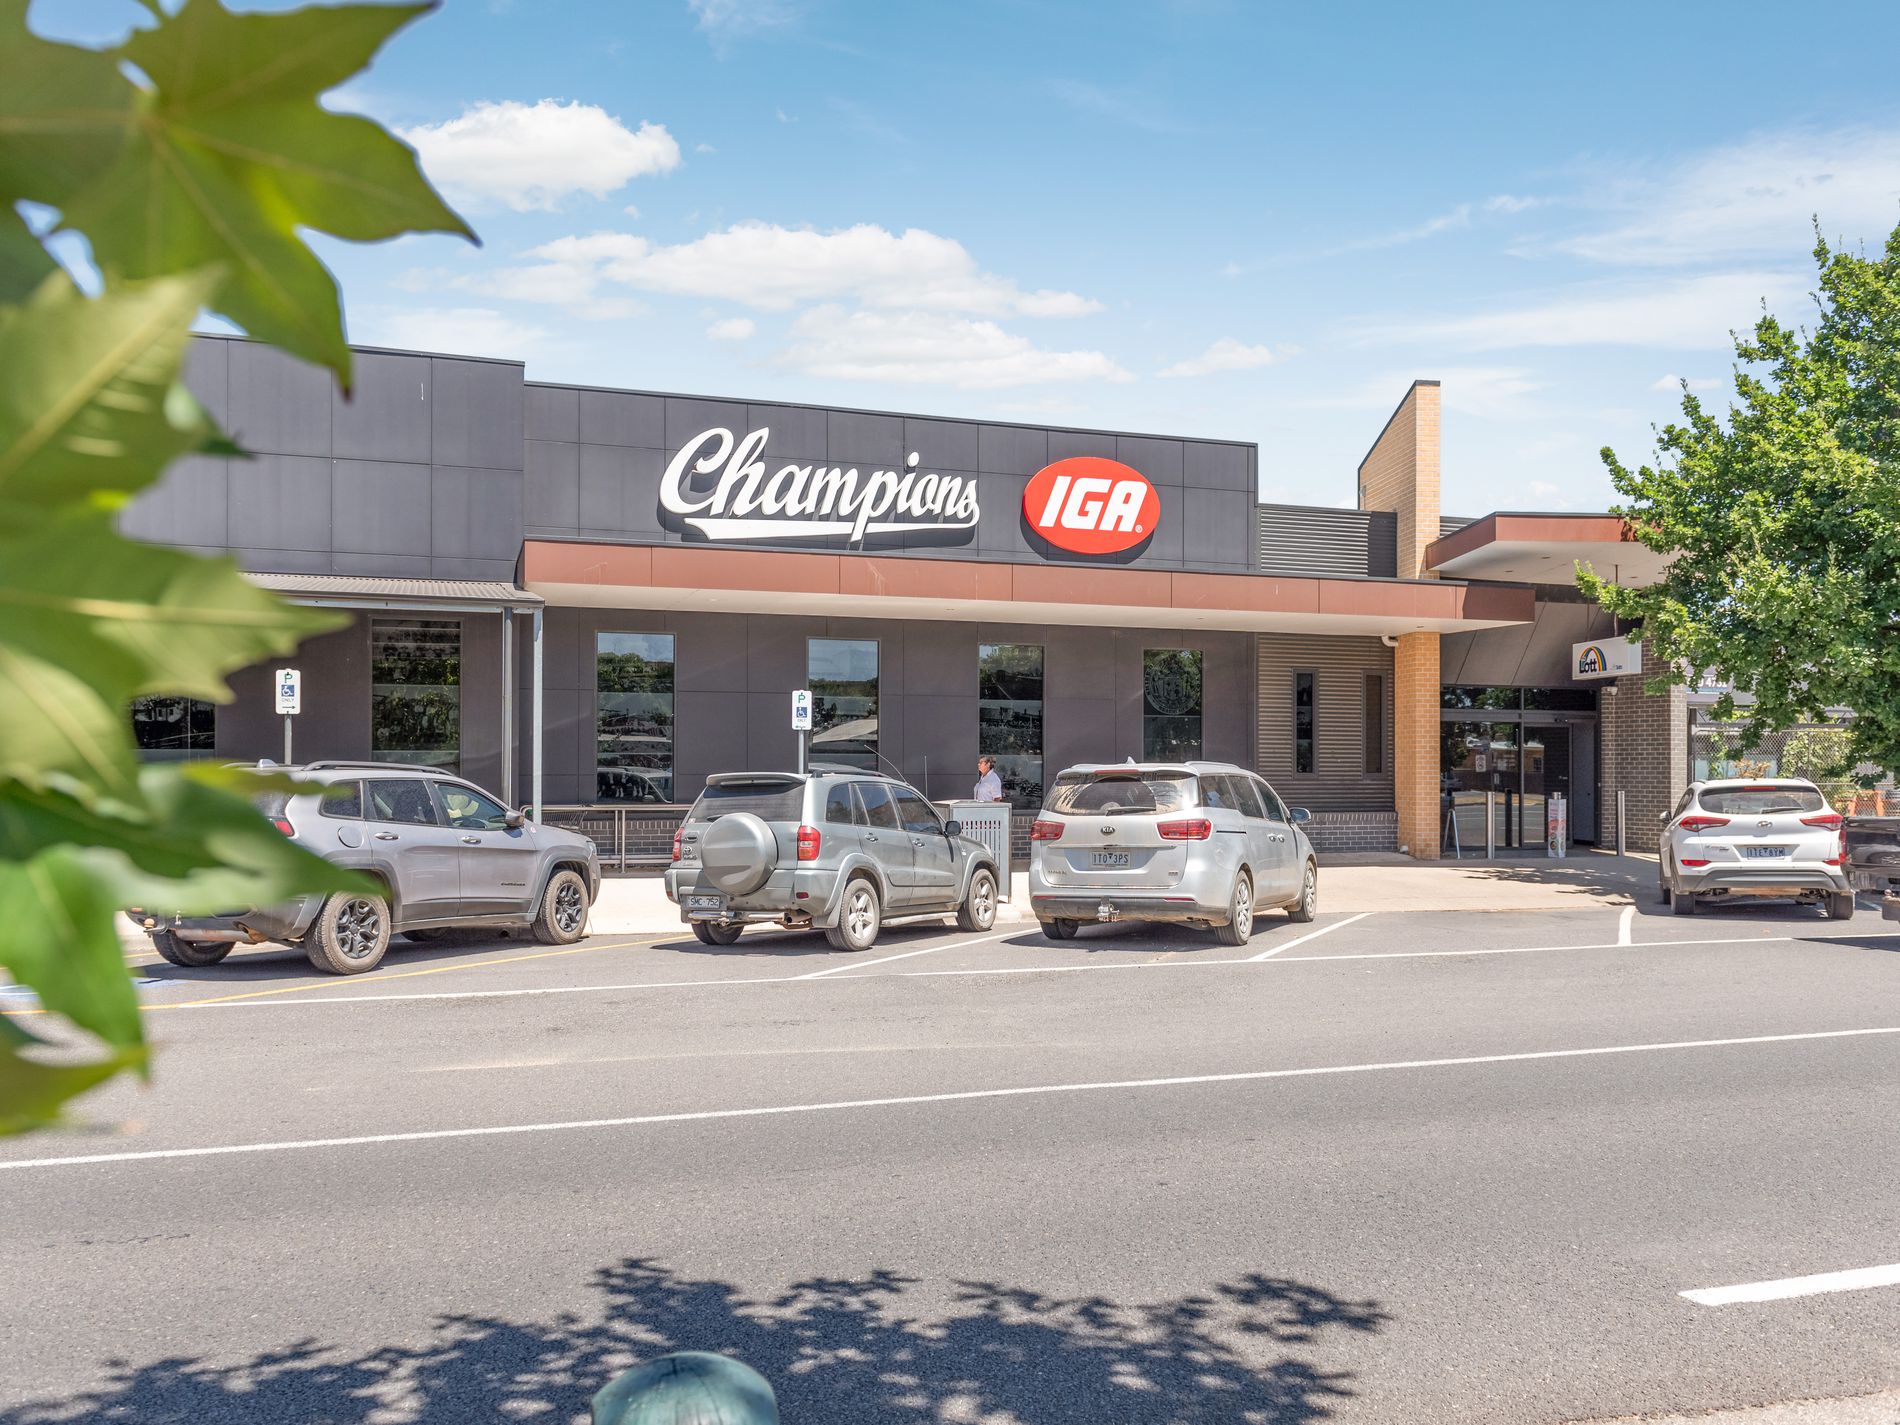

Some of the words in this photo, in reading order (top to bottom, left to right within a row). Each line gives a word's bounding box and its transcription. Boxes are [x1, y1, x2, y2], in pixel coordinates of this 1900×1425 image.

[659, 427, 980, 542] Champions
[1039, 475, 1148, 532] IGA
[1579, 659, 1597, 673] Lott
